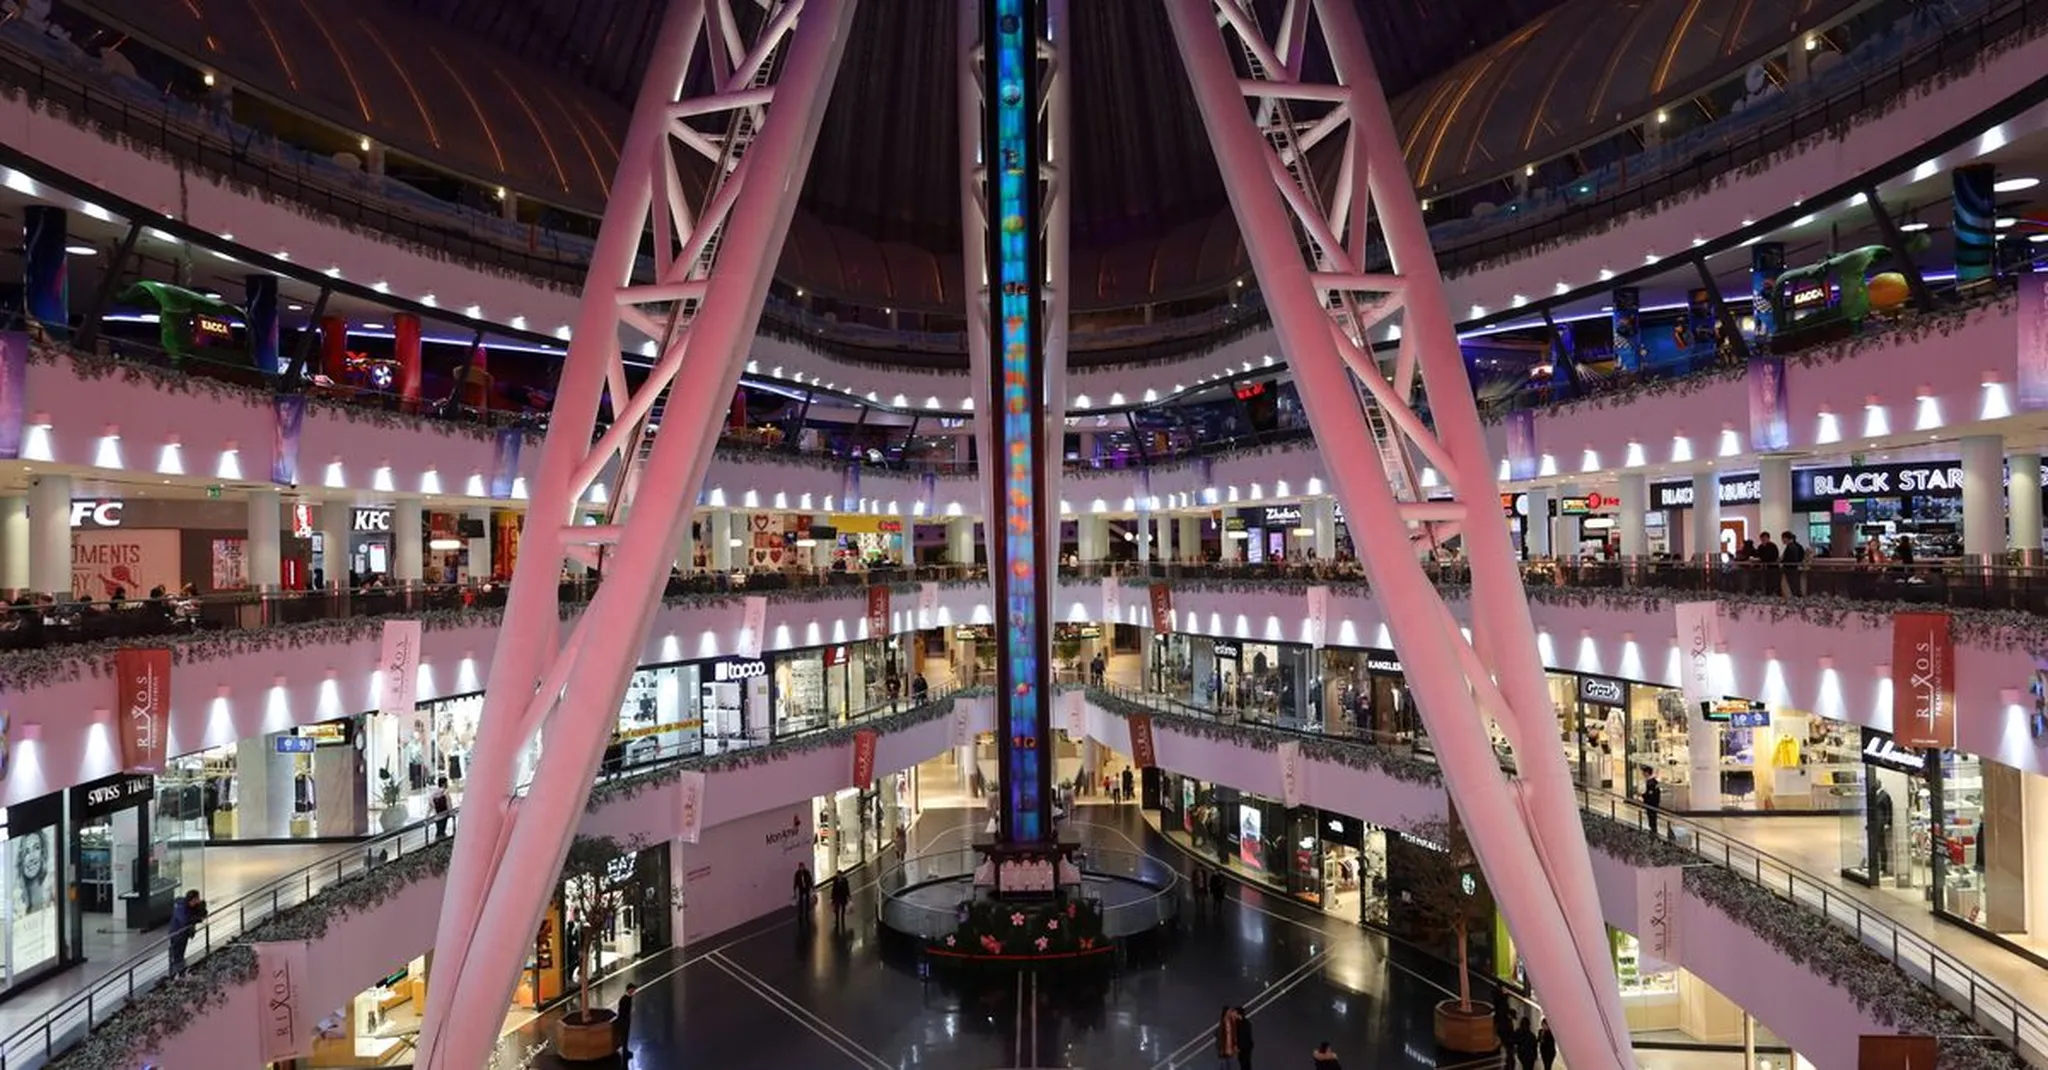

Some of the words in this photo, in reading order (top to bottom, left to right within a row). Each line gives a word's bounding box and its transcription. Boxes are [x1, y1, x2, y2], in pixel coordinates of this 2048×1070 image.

[1813, 471, 1891, 496] BLACK
[69, 501, 123, 527] FC
[354, 510, 390, 530] KFC
[71, 544, 140, 564] MENTS
[1911, 641, 1934, 719] RIXOS
[131, 674, 152, 749] RIXOS
[88, 784, 121, 807] SWISS
[270, 969, 291, 1037] RIXOS
